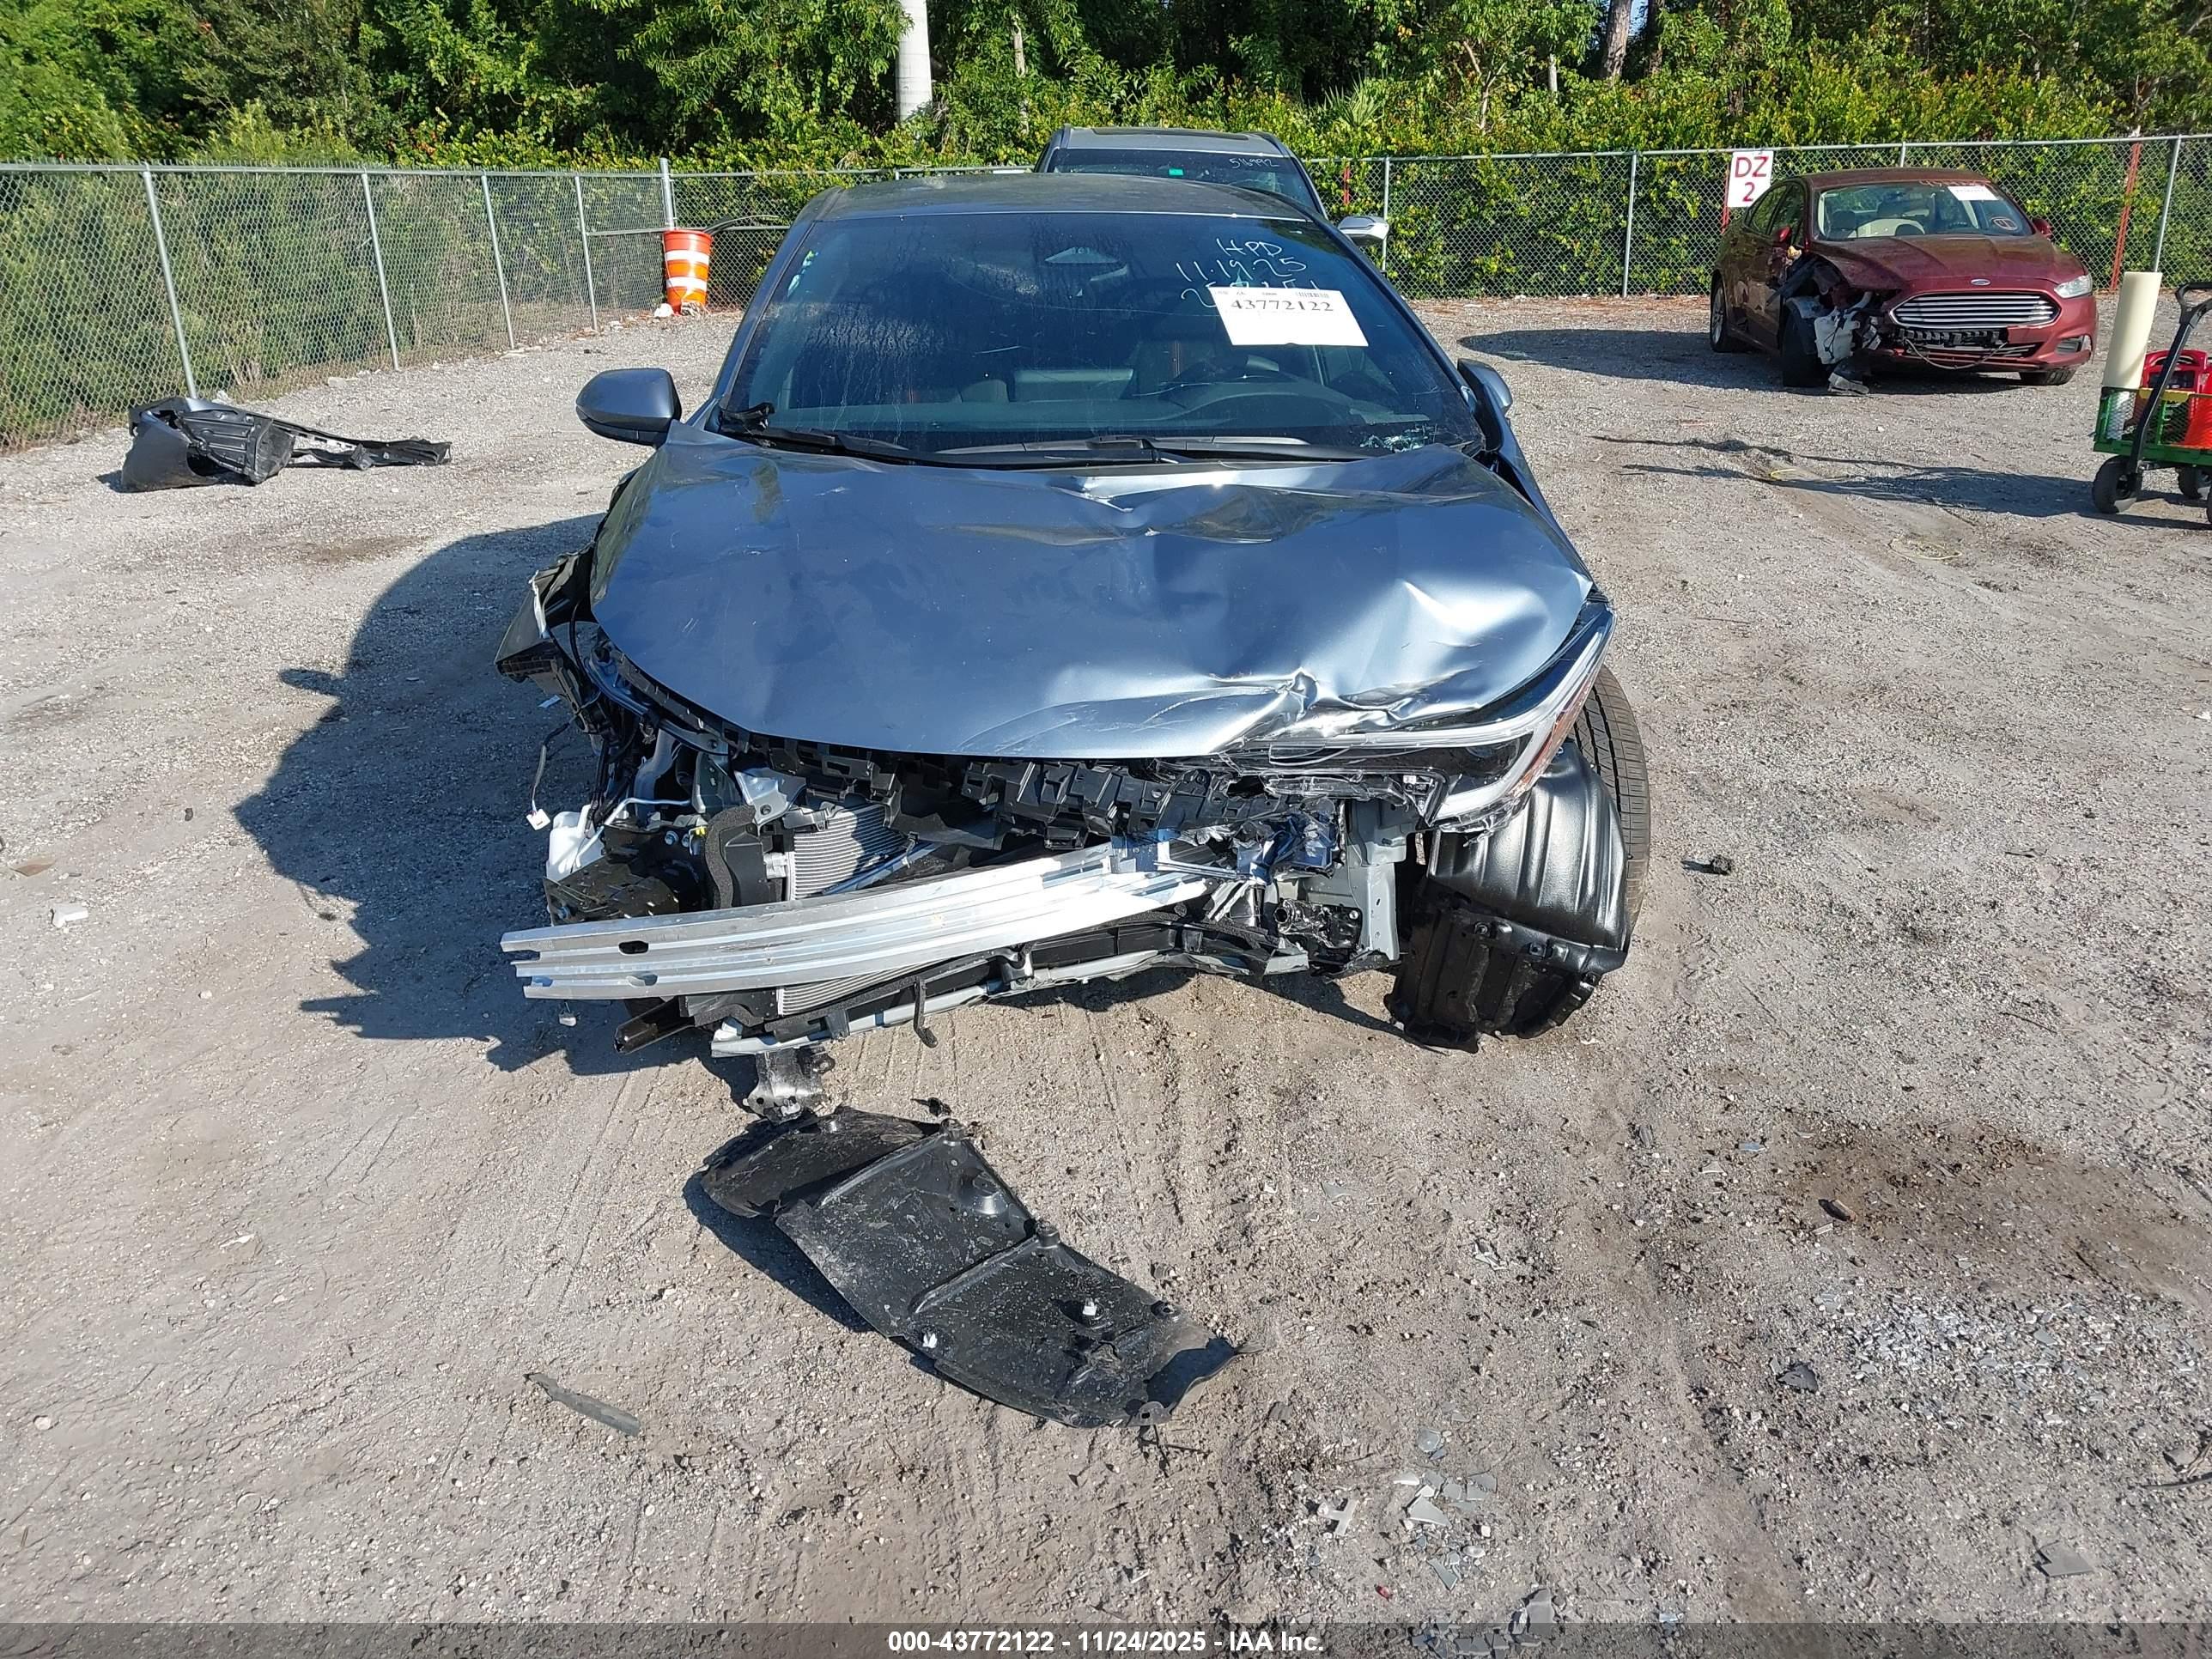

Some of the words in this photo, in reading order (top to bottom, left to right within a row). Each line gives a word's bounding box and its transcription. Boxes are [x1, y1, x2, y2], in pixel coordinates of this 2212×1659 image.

[1735, 156, 1769, 178] DZ
[1742, 181, 1756, 202] 2
[1216, 238, 1282, 257] HPD
[1231, 300, 1334, 312] 43772122
